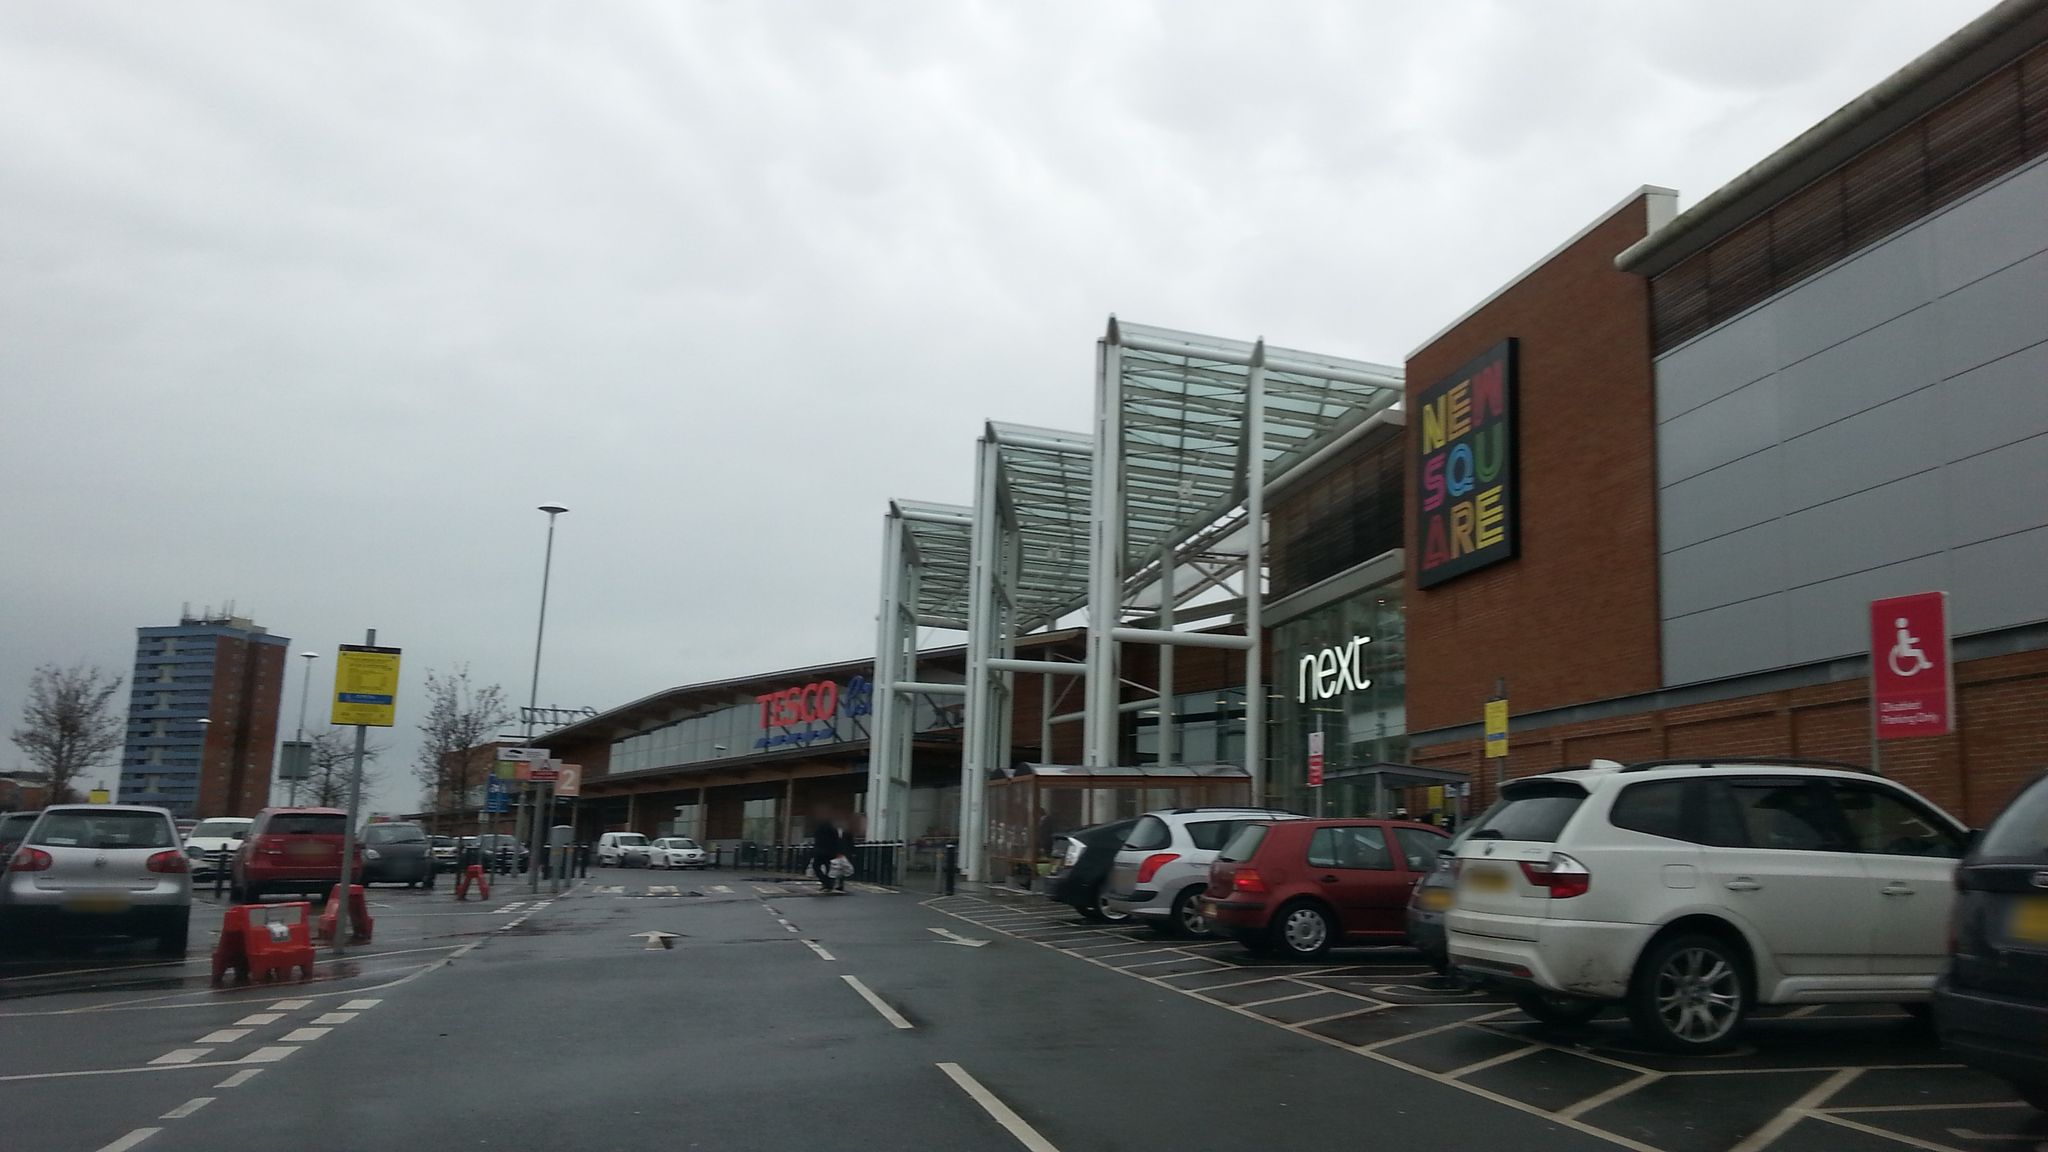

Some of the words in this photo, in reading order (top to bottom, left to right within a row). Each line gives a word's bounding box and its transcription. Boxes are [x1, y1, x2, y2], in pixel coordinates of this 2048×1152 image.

[1422, 361, 1504, 455] NEW
[1422, 422, 1504, 512] SQU
[1421, 484, 1504, 570] ARE
[755, 680, 837, 729] TESCO
[1299, 635, 1371, 703] next
[562, 768, 577, 790] 2
